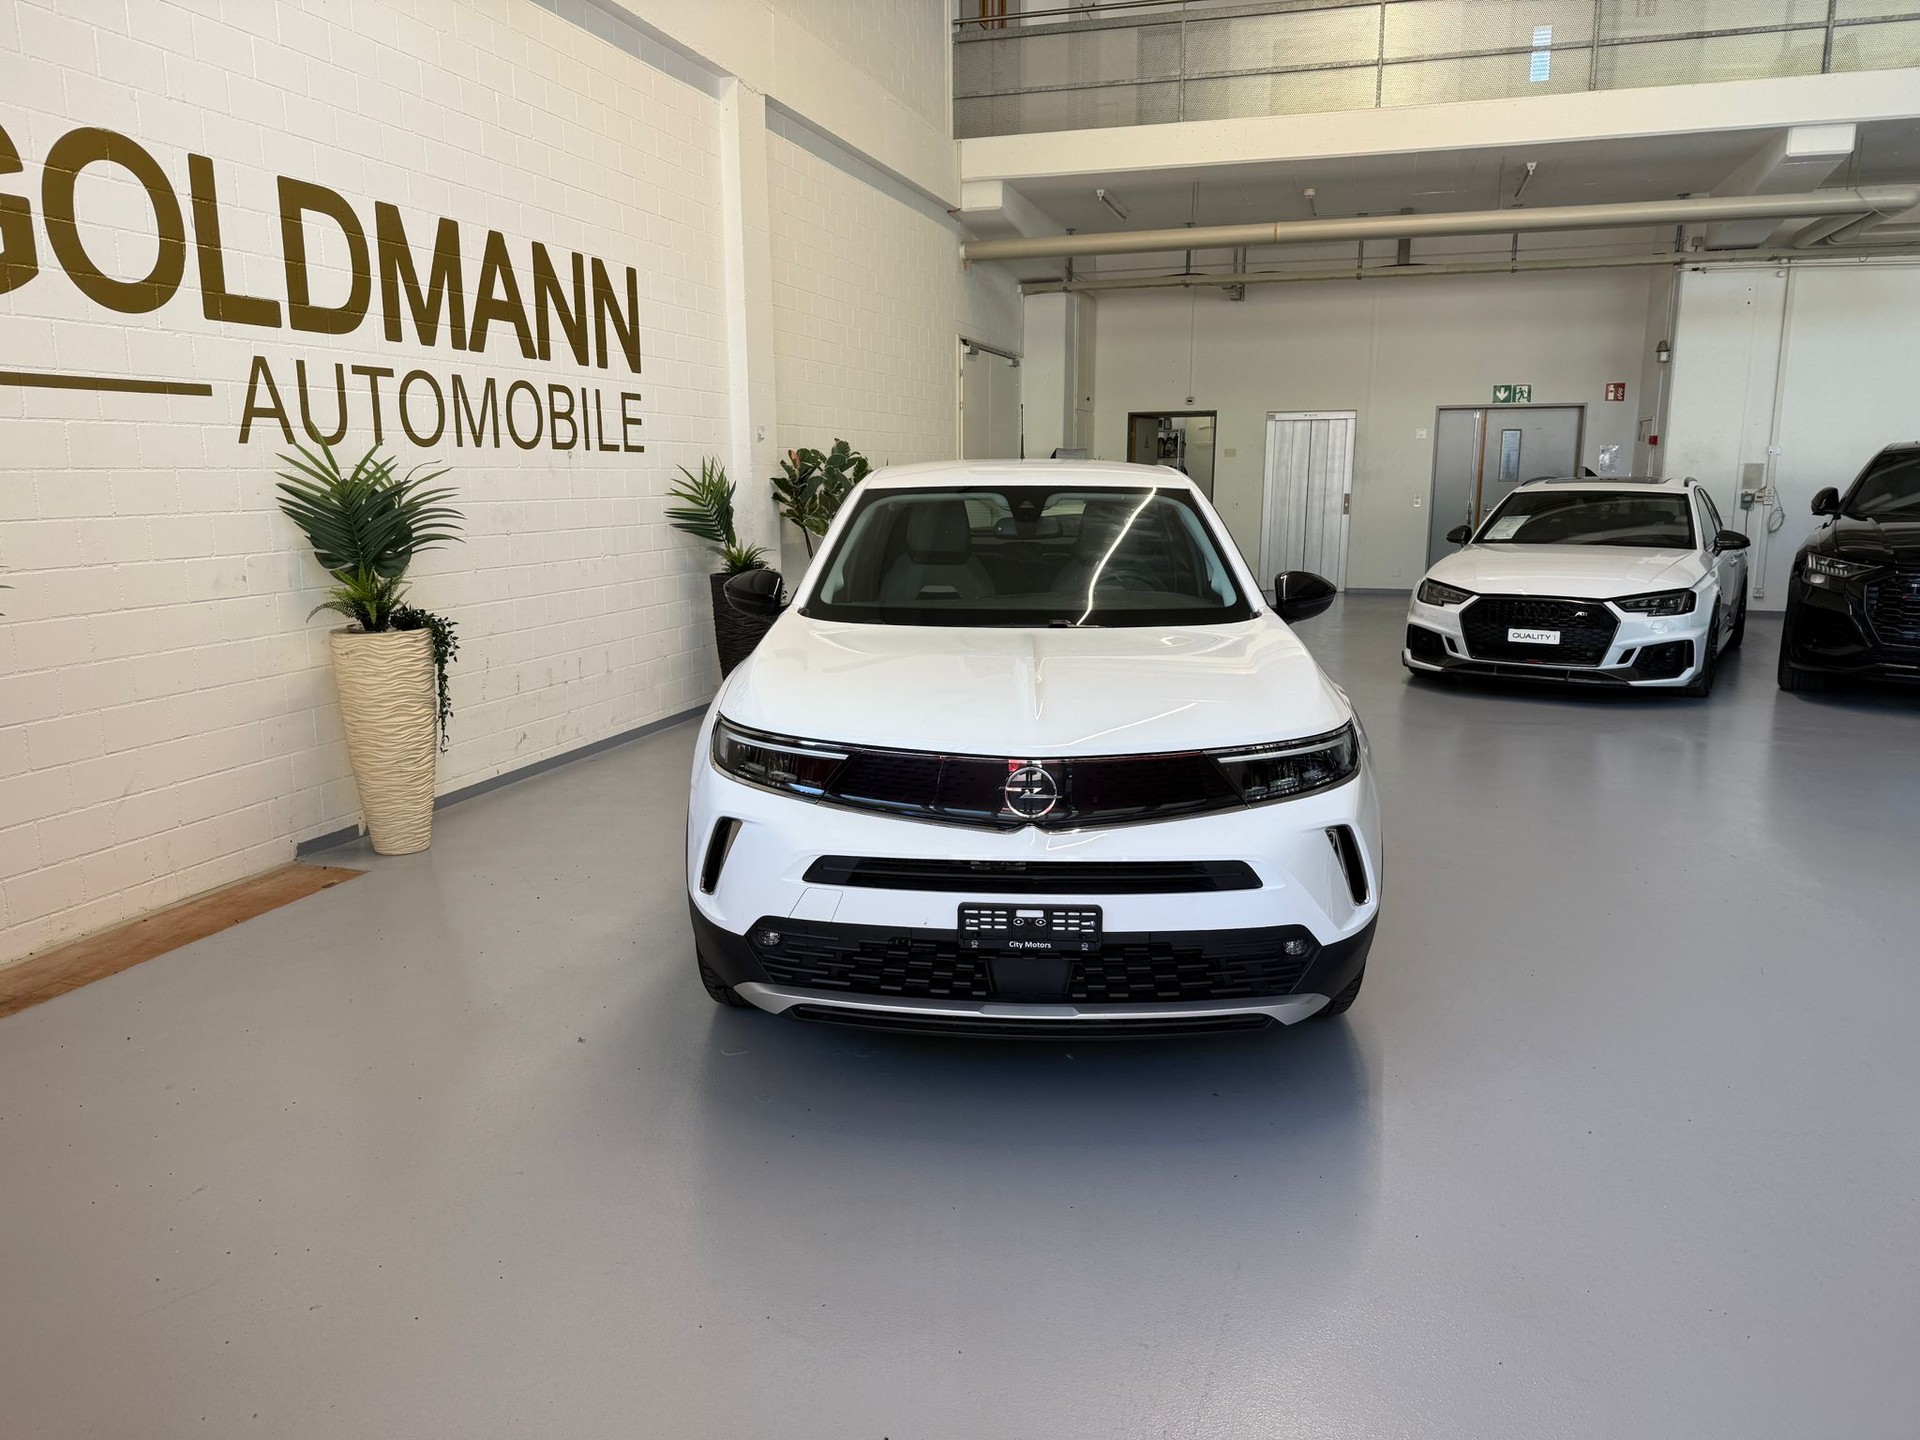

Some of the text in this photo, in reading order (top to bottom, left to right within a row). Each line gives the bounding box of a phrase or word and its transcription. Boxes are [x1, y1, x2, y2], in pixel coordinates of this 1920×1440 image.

[238, 355, 645, 453] AUTOMOBILE
[1512, 632, 1551, 640] QUALITY
[1008, 940, 1052, 949] City Motors
